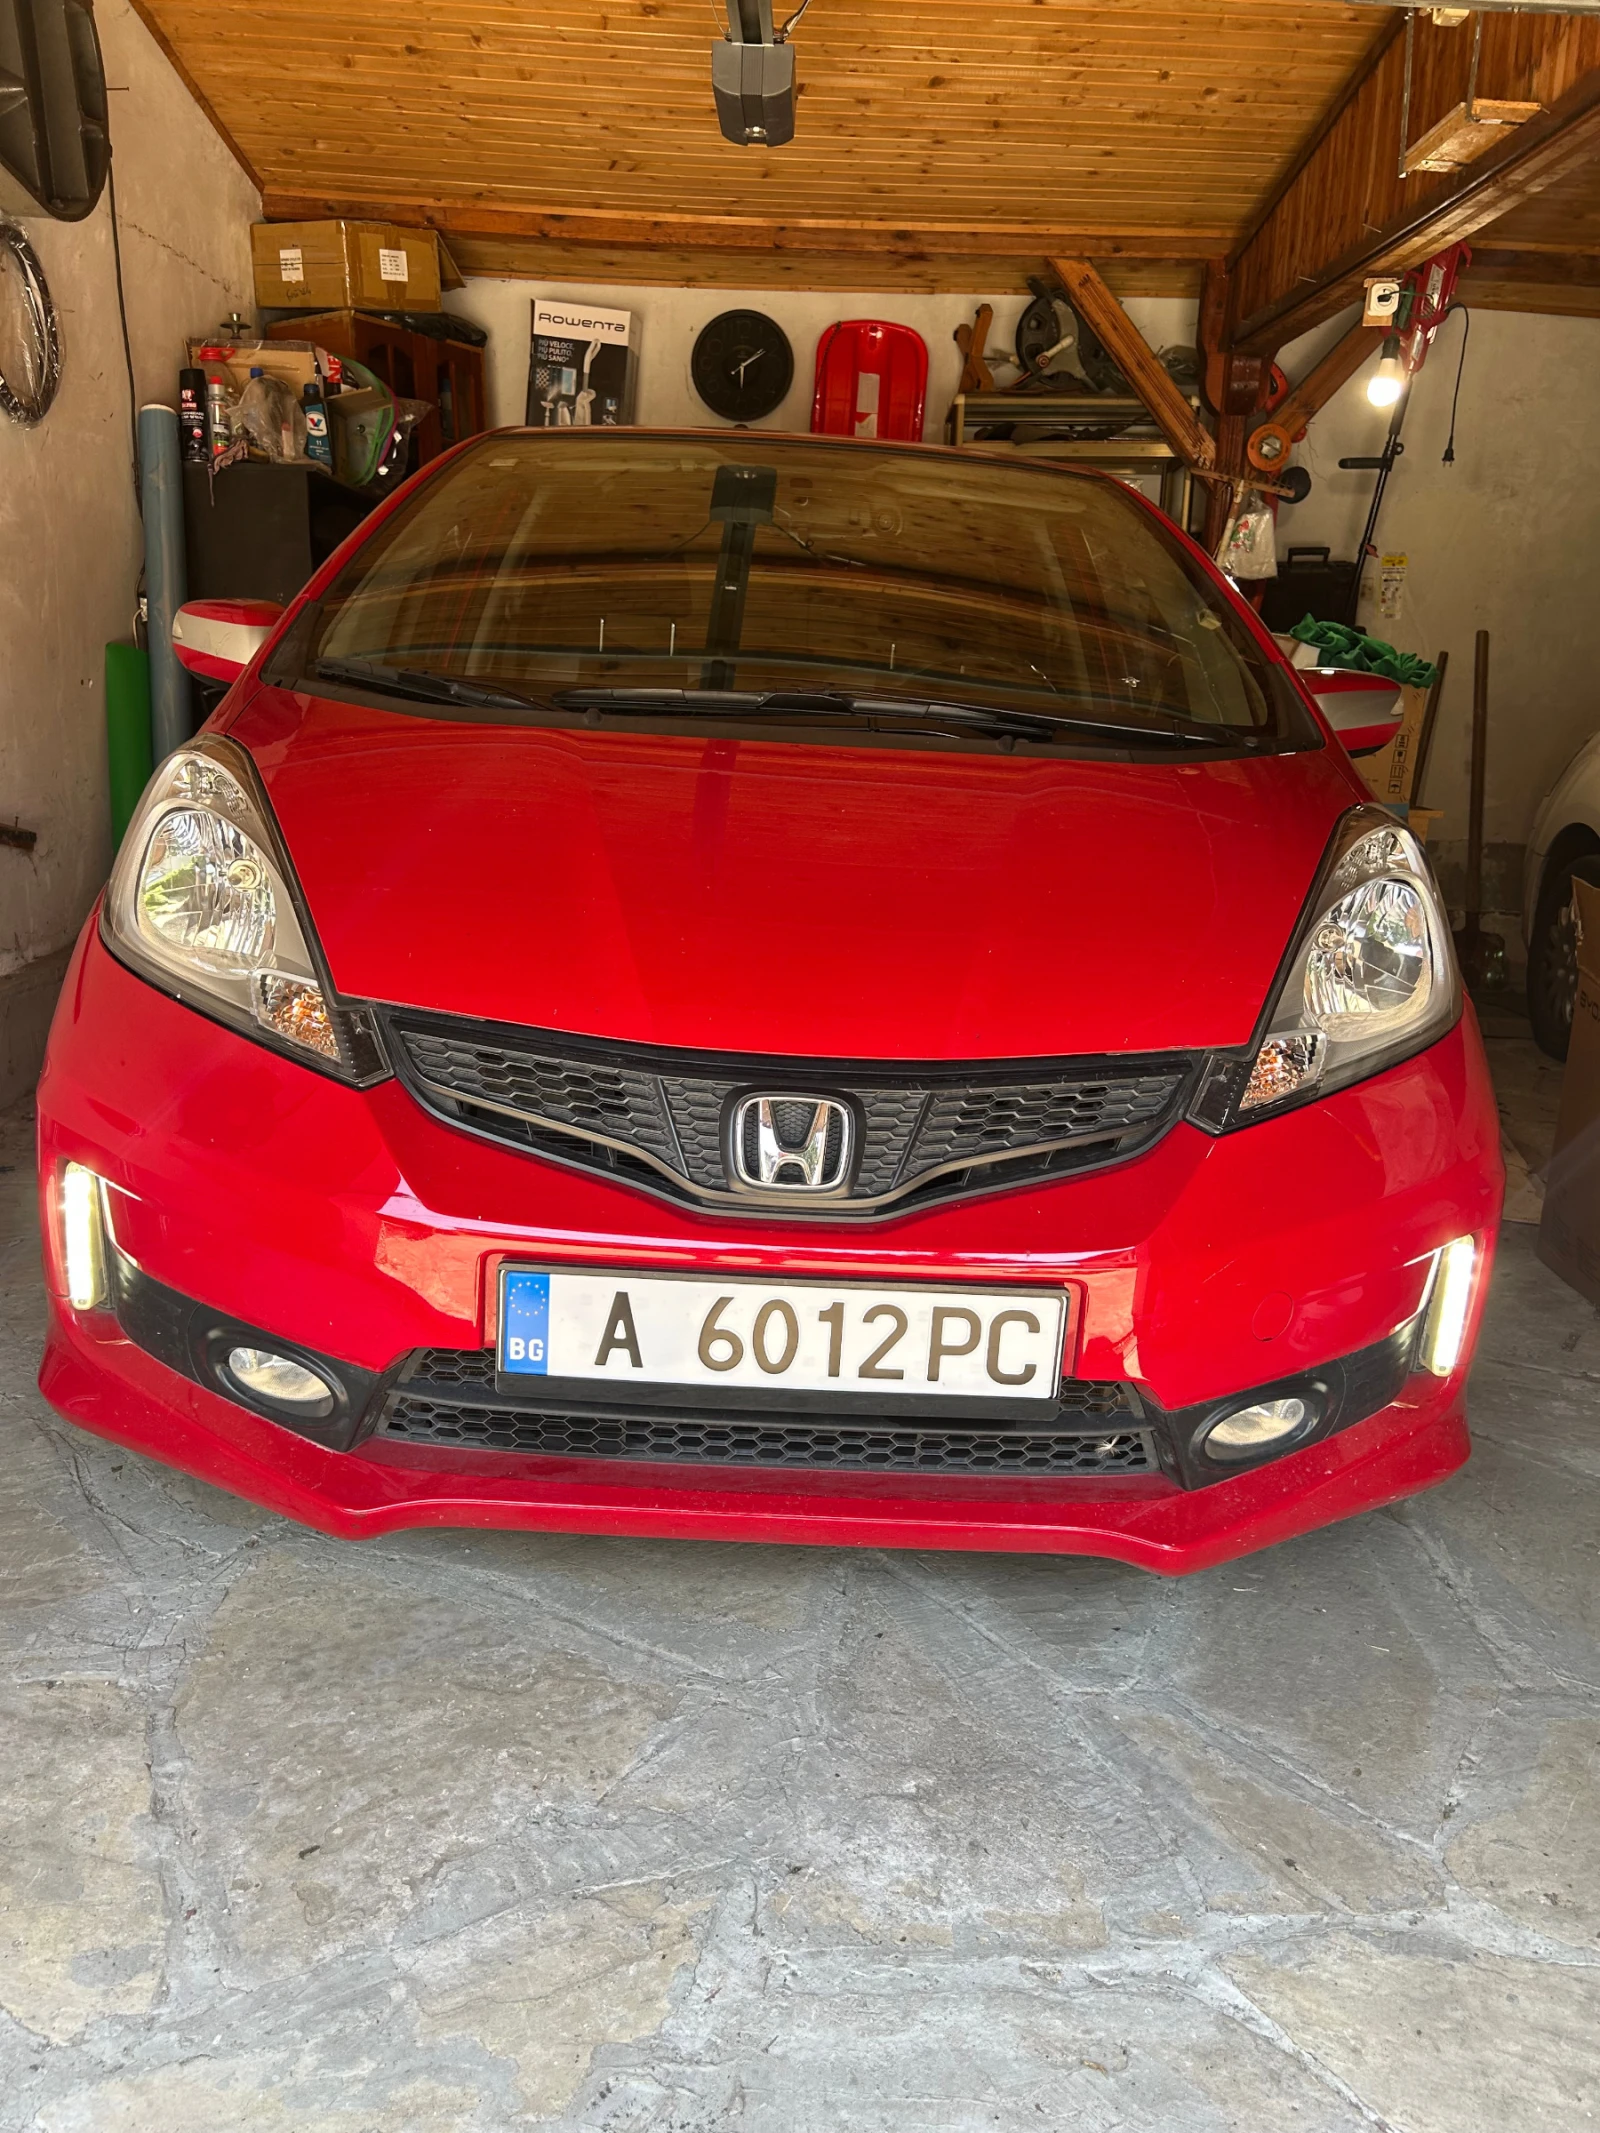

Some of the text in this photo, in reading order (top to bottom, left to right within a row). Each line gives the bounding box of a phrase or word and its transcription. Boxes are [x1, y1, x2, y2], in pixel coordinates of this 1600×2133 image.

[1580, 988, 1600, 1023] BYO
[594, 1291, 644, 1368] A
[509, 1336, 544, 1361] BG
